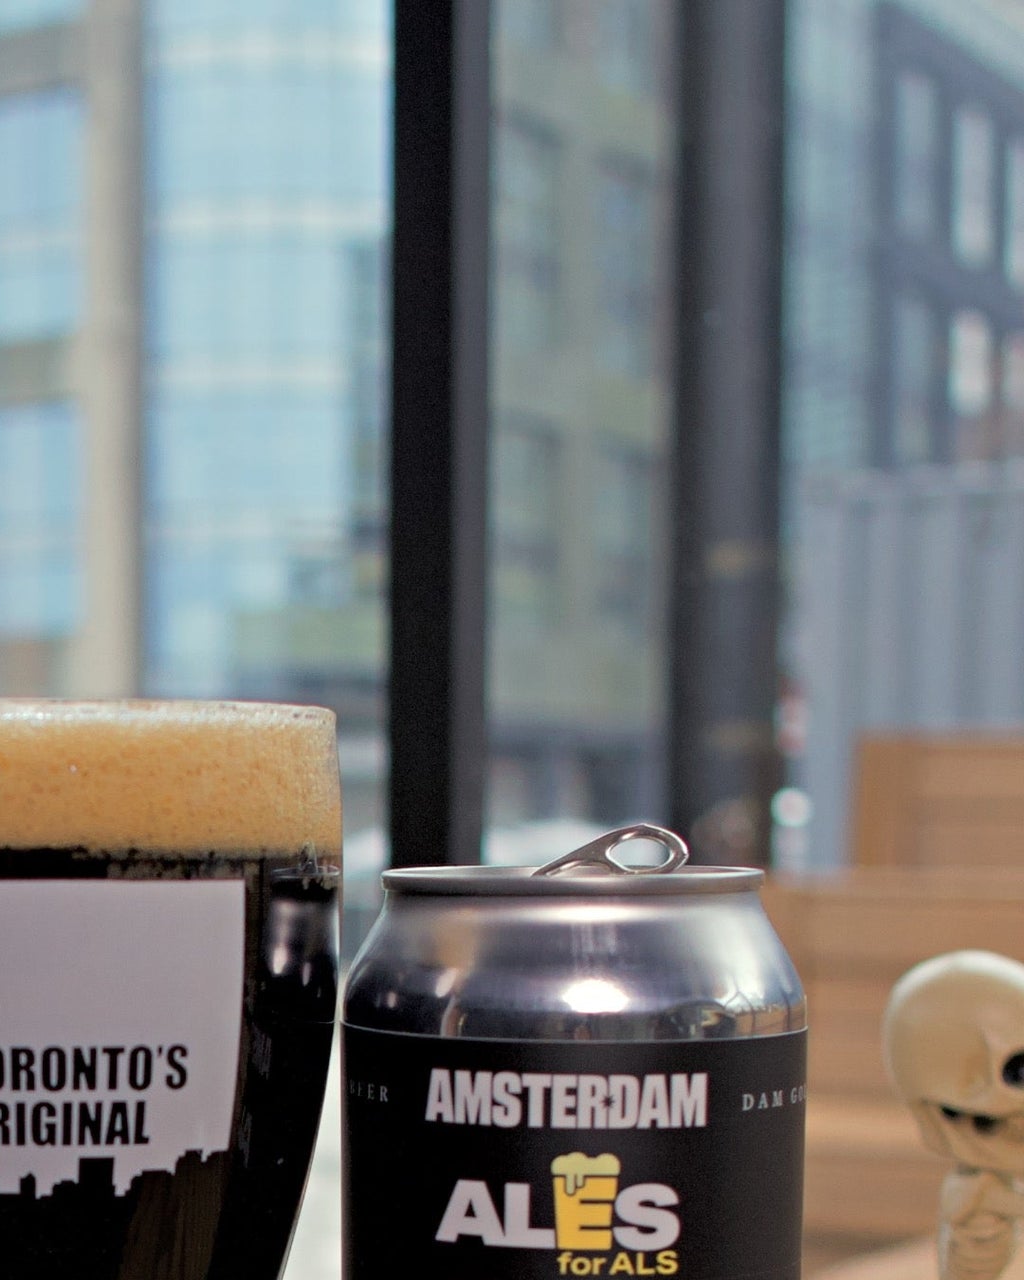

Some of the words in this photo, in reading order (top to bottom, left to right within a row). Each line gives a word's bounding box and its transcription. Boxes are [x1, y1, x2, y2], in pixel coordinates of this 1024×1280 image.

[425, 1068, 708, 1129] AMSTERDAM
[742, 1090, 784, 1111] DAM
[790, 1083, 808, 1104] GO
[435, 1153, 681, 1252] ALES
[557, 1250, 607, 1276] for
[609, 1249, 679, 1276] ALS
